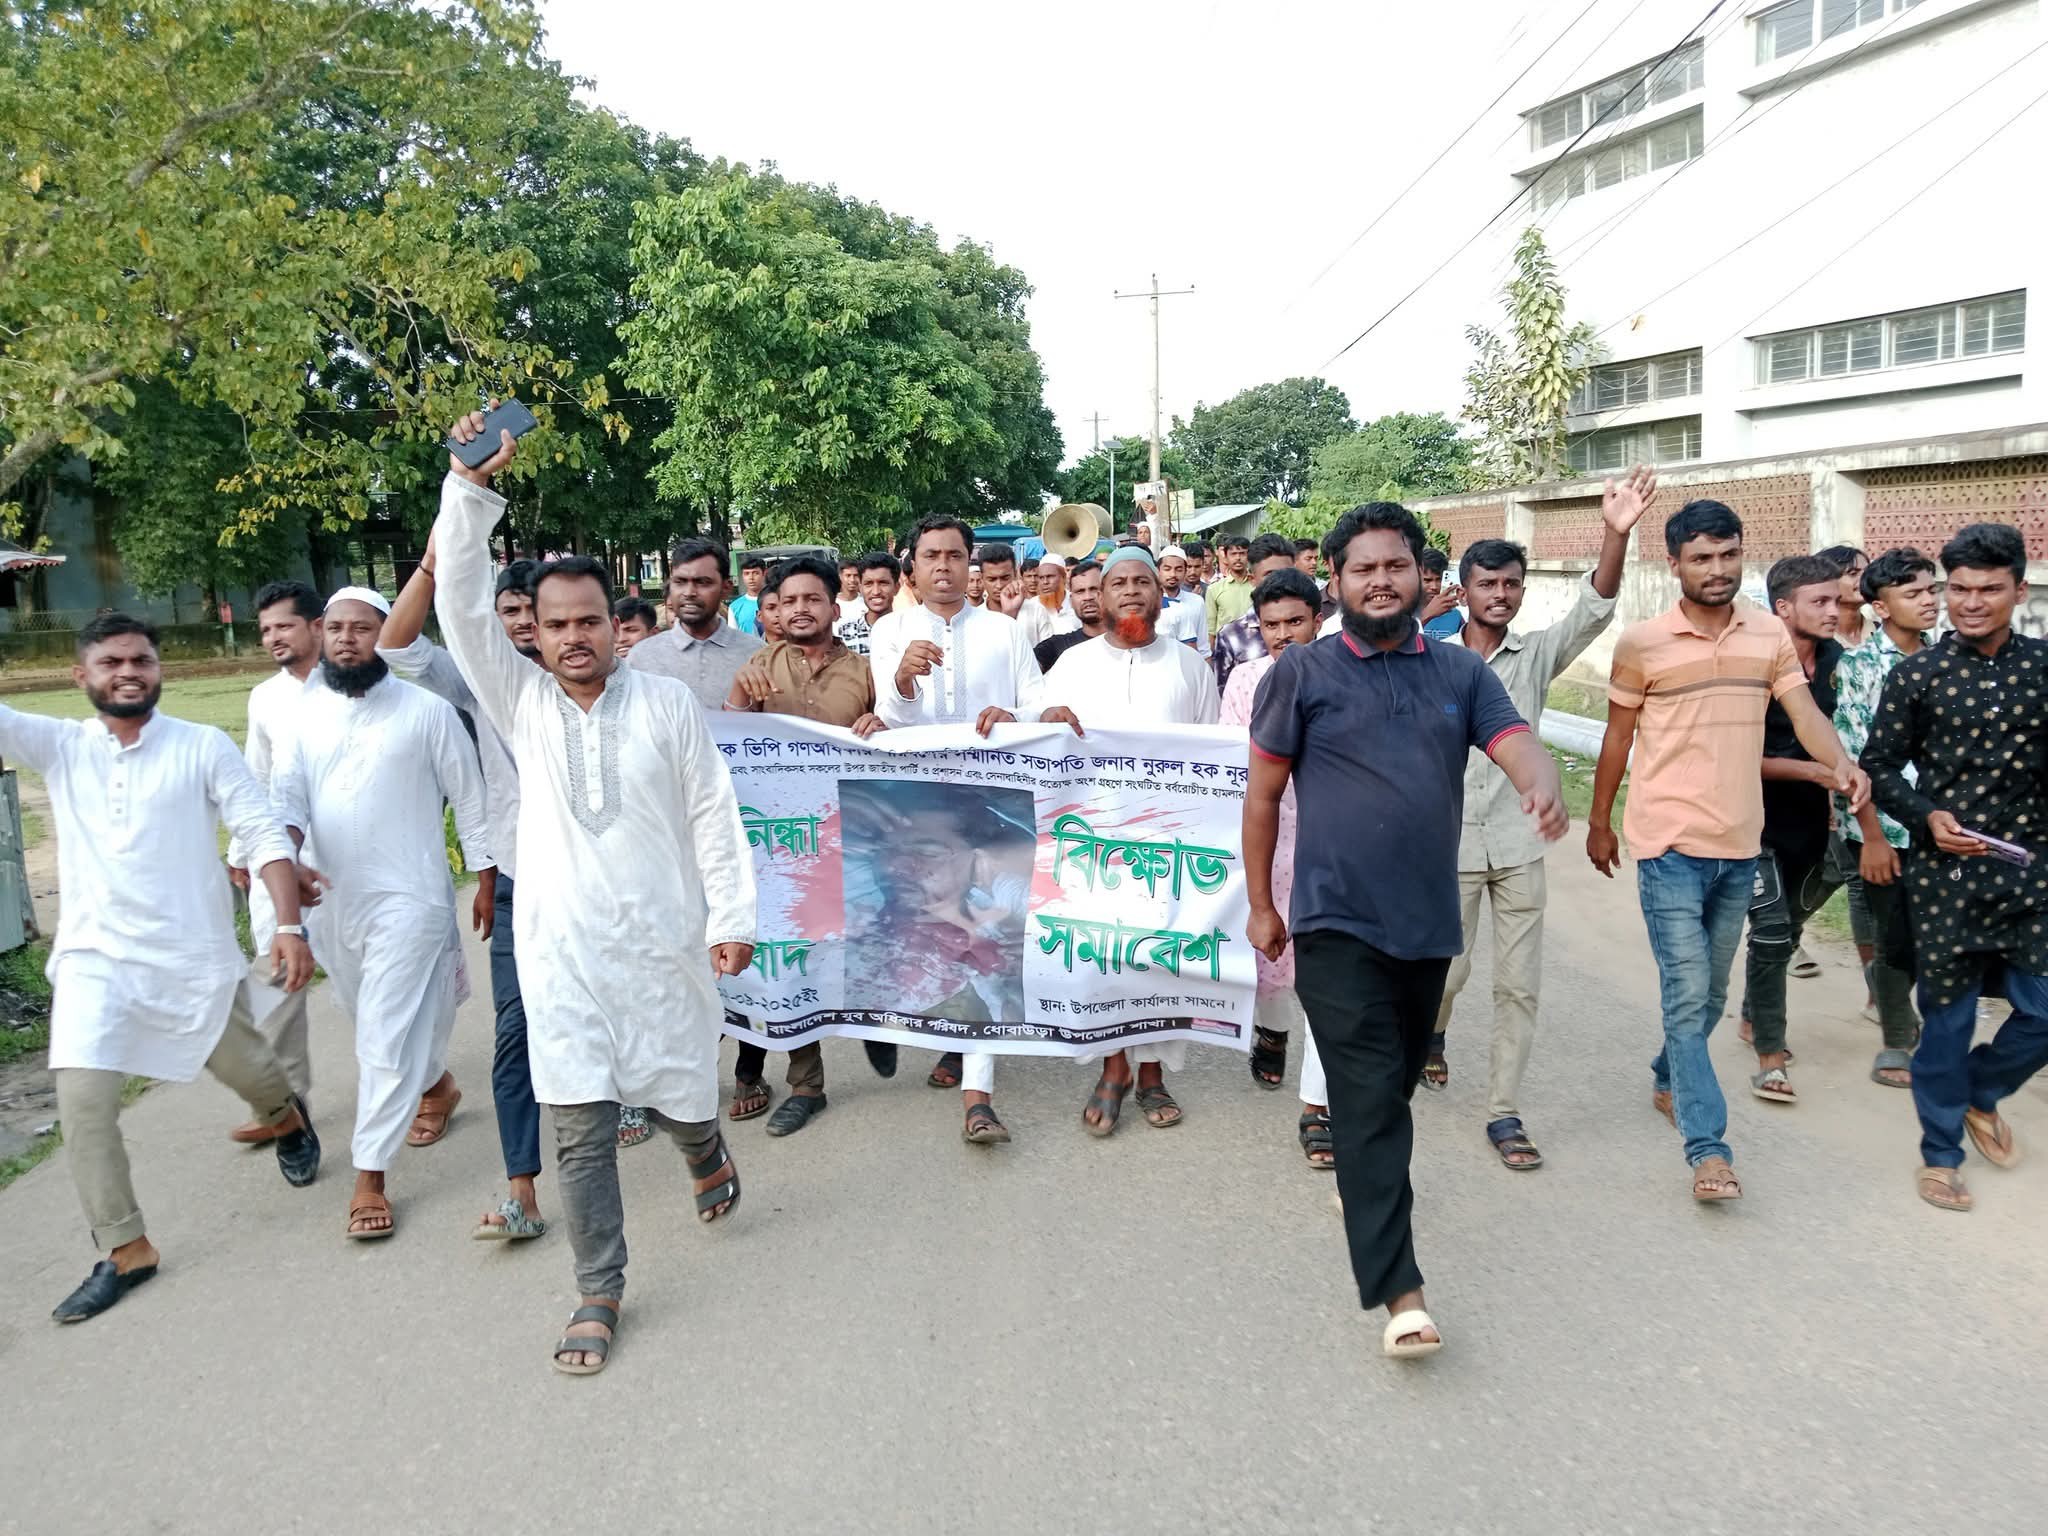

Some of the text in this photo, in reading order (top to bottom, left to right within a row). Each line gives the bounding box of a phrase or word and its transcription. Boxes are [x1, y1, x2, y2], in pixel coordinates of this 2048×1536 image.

[742, 738, 781, 757] ভিপি
[1020, 754, 1085, 774] সভাপতি
[1090, 756, 1136, 772] জনাব
[1141, 758, 1185, 777] নুরুল
[1190, 761, 1220, 779] হক
[844, 762, 865, 773] উপর
[922, 767, 930, 775] ও
[965, 770, 983, 780] এবং
[1074, 777, 1096, 786] অংশ
[1050, 813, 1235, 900] বিক্ষোভ
[1035, 914, 1231, 982] সমাবেশ
[1070, 999, 1126, 1014] উপজেলা
[1129, 993, 1180, 1008] কার্যালয়
[1184, 996, 1225, 1009] সামনে
[768, 1012, 834, 1035] বাংলাদেশ
[868, 1011, 923, 1028] অধিকার
